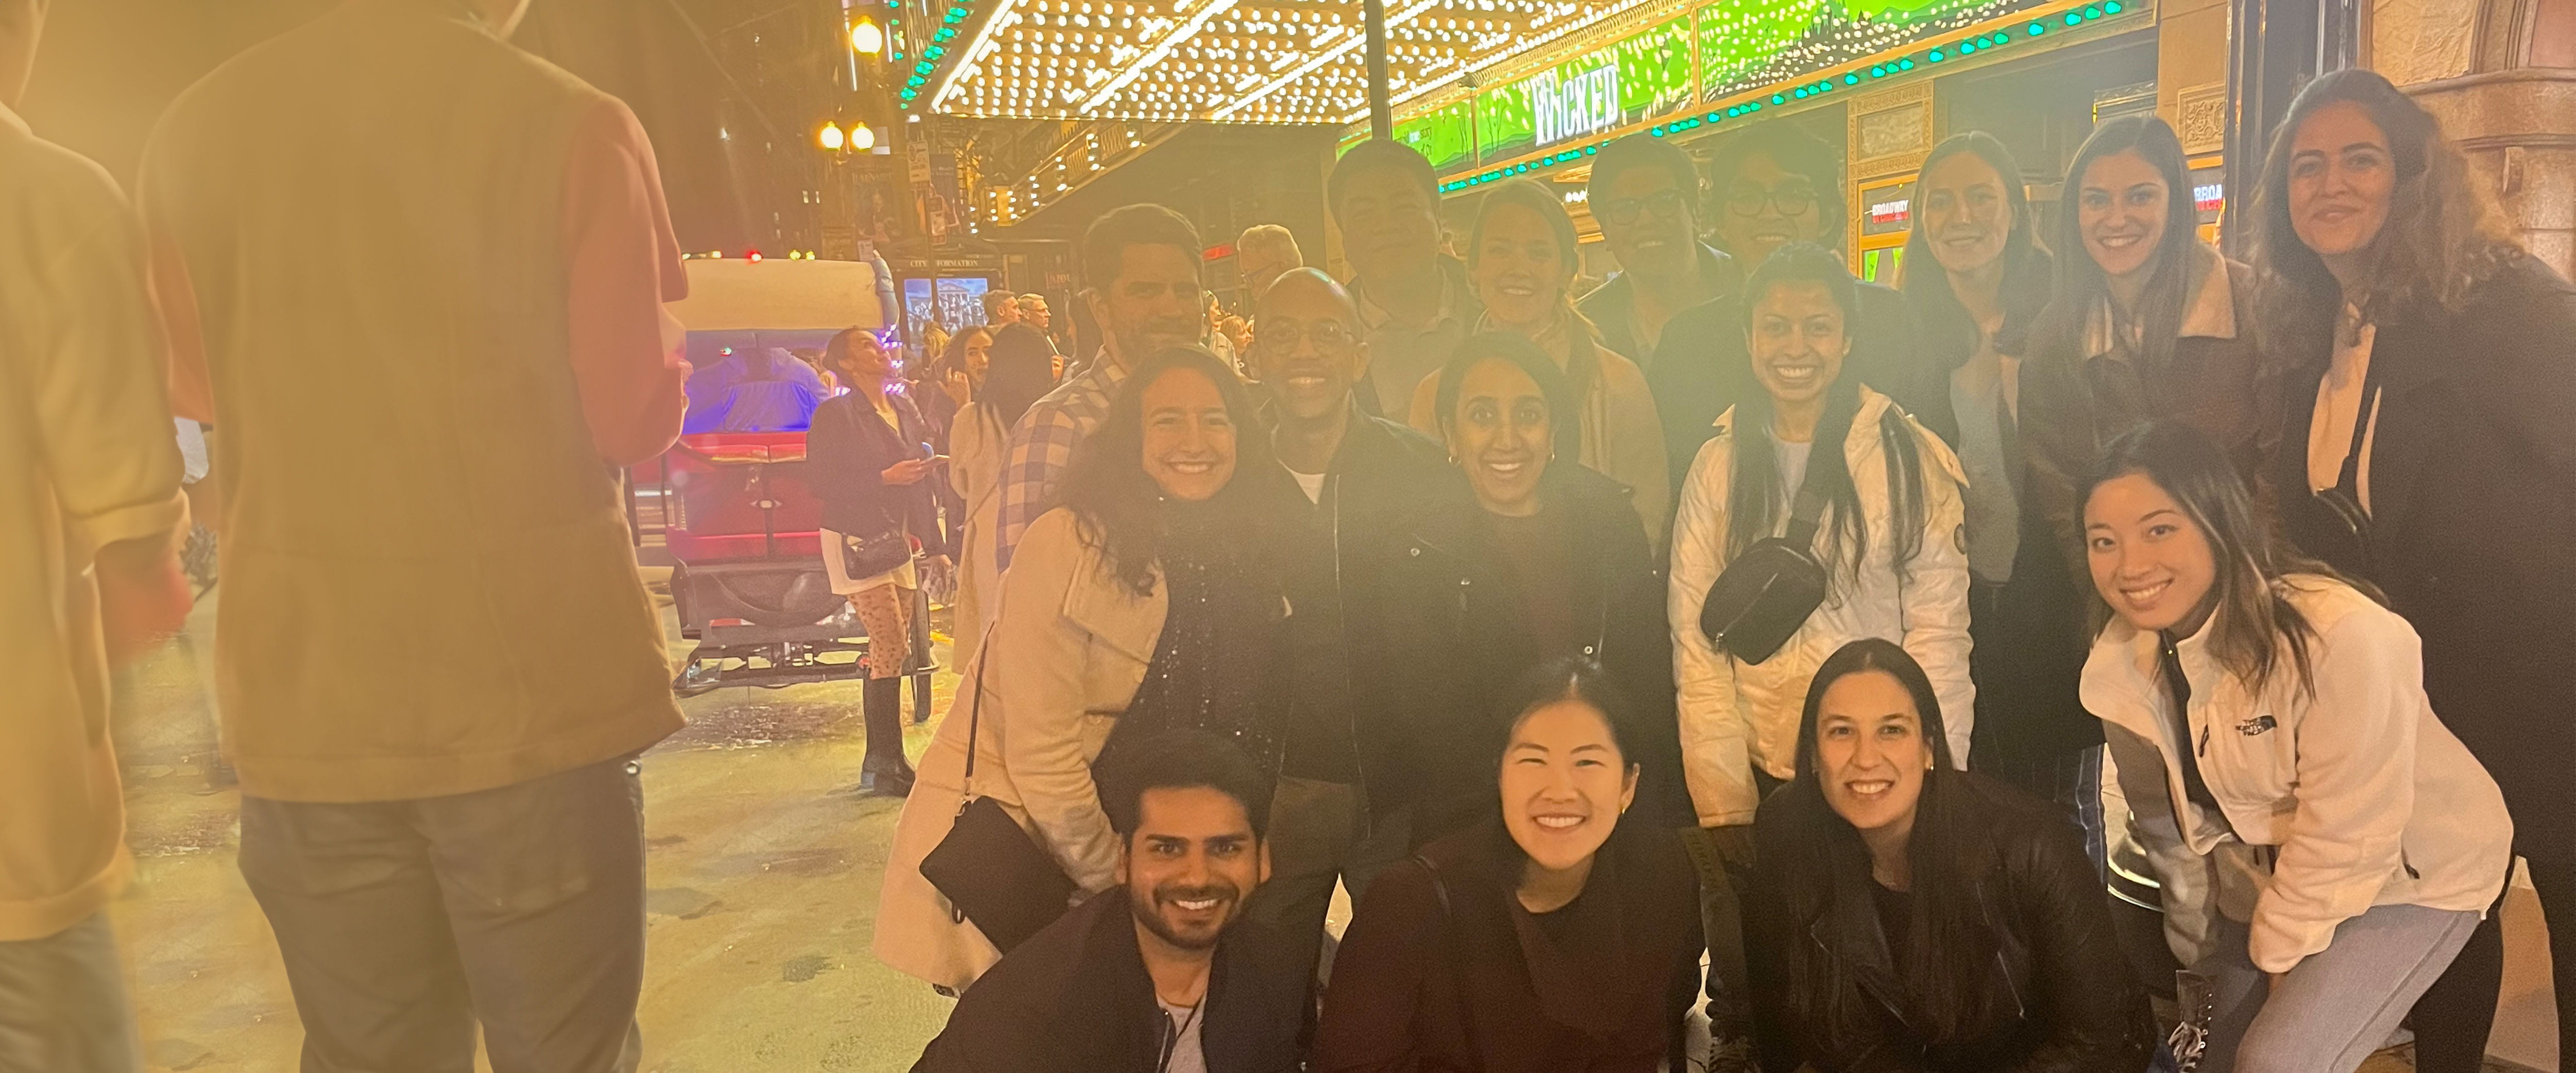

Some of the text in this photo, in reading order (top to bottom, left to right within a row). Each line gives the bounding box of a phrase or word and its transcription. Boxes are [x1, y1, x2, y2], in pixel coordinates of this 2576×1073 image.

[1530, 65, 1618, 146] WICKED
[2194, 184, 2223, 201] BROA
[1872, 199, 1908, 216] BROADWAY
